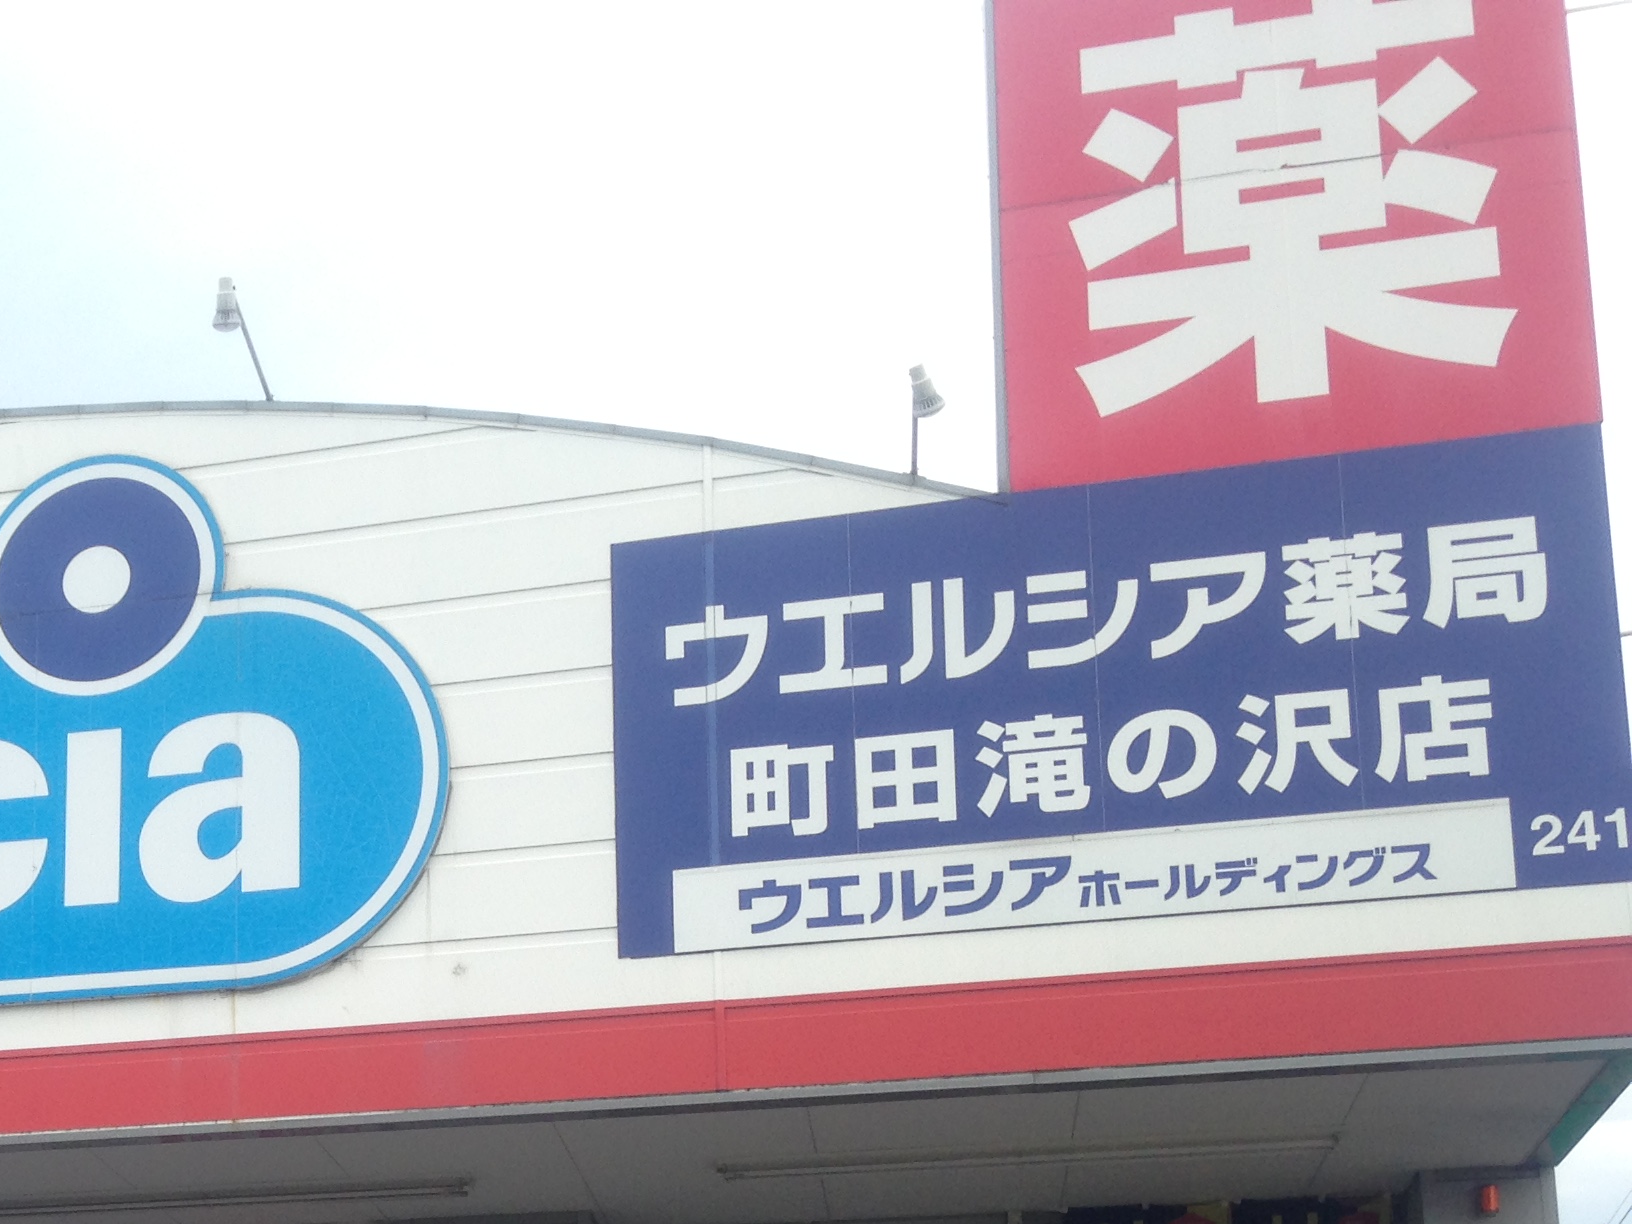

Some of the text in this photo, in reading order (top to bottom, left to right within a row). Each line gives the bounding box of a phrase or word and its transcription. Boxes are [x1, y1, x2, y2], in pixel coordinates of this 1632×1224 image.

[1069, 0, 1517, 417] 薬
[665, 516, 1549, 708] ウエルシア薬局
[729, 674, 1493, 837] 町田滝の沢店
[1530, 807, 1628, 856] 241
[737, 843, 1438, 935] ウエルシアホールディングス
